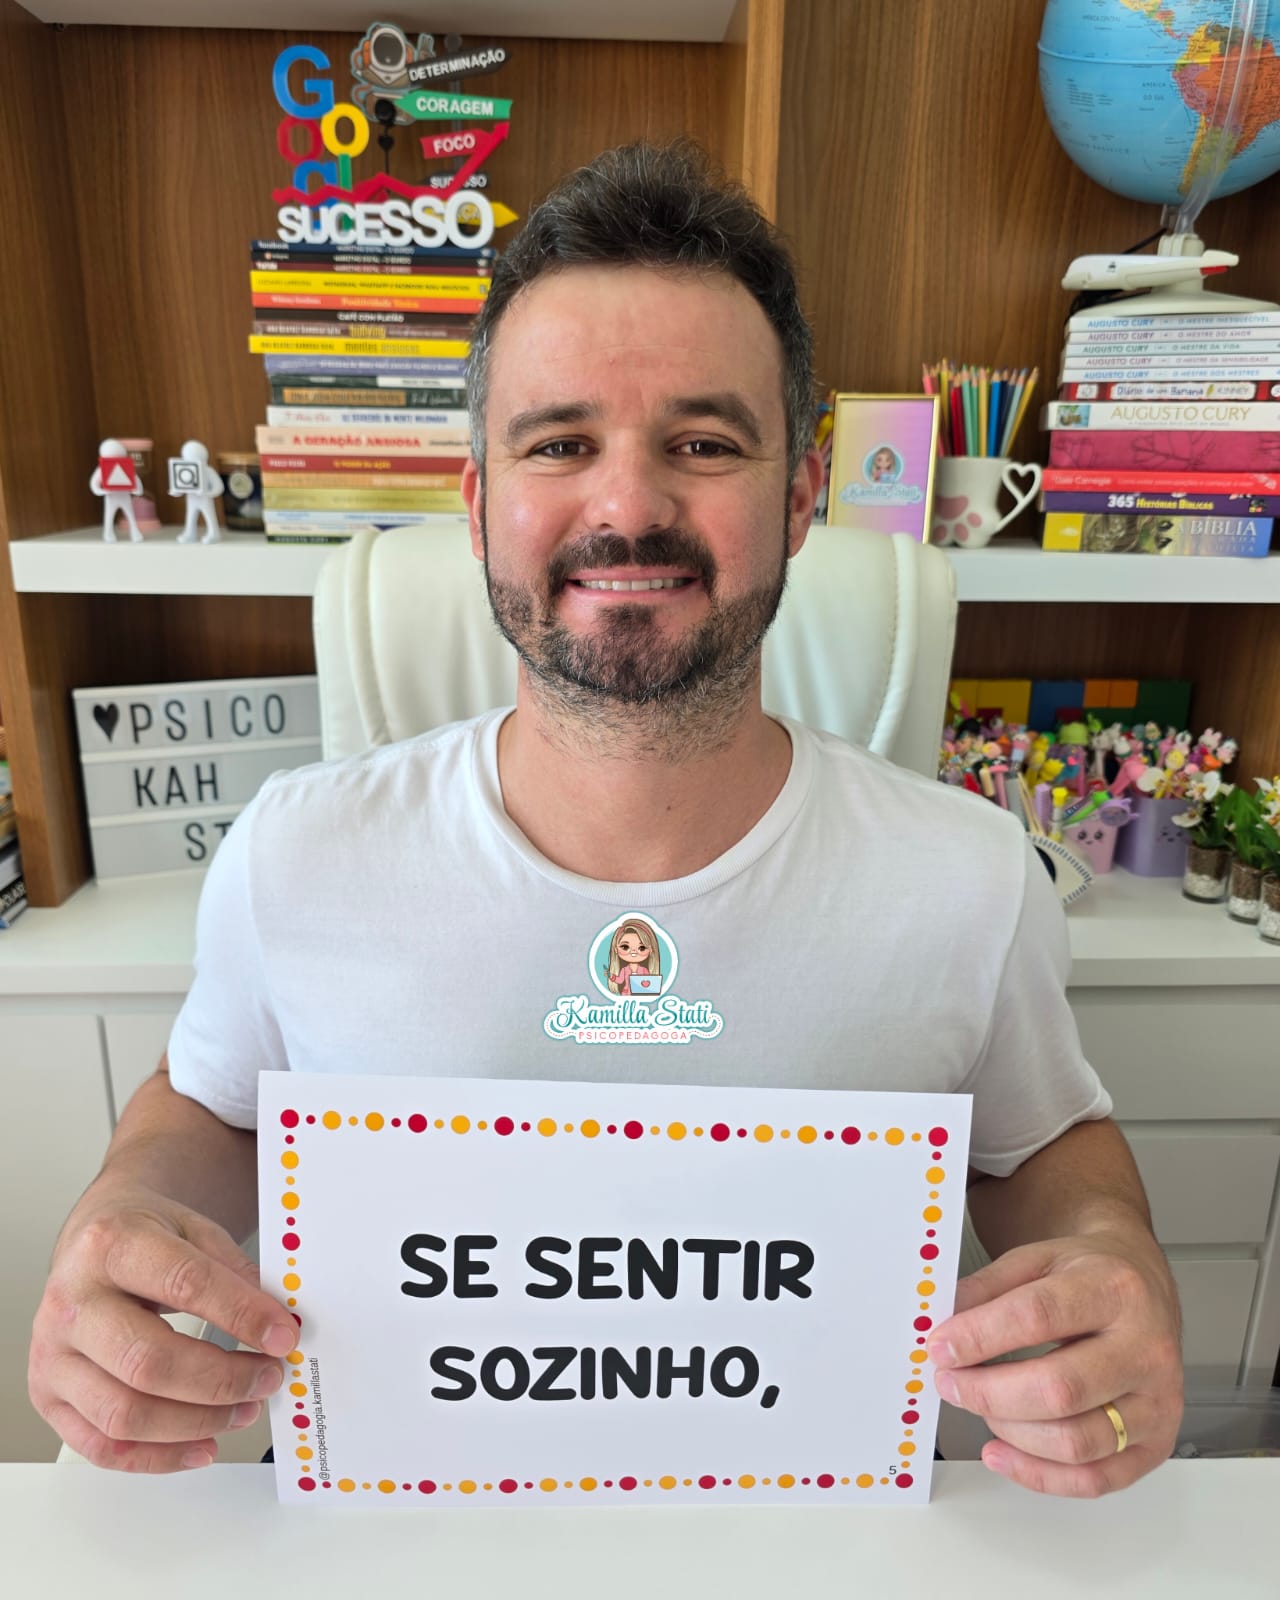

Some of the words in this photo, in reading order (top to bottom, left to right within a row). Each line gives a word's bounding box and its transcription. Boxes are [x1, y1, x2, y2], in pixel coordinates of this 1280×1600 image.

[409, 48, 506, 82] DETERMINAÇÃO
[416, 96, 495, 116] CORAGEM
[433, 133, 476, 155] FOCO
[277, 190, 494, 249] SUCESSO
[1087, 319, 1129, 328] AUGUSTO
[1131, 318, 1154, 327] CURY
[1087, 332, 1129, 341] AUGUSTO
[1131, 331, 1154, 340] CURY
[1082, 345, 1123, 353] AUGUSTO
[1125, 345, 1149, 353] CURY
[1086, 358, 1127, 366] AUGUSTO
[1129, 357, 1152, 366] CURY
[1083, 371, 1124, 379] AUGUSTO
[1127, 371, 1149, 379] CURY
[1110, 405, 1199, 421] AUGUSTO
[1202, 405, 1251, 421] CURY
[304, 432, 362, 449] GERAÇÃO
[1107, 494, 1135, 509] 365
[130, 694, 286, 744] PSICO
[134, 762, 219, 808] KAH
[400, 1233, 499, 1299] SE
[525, 1236, 816, 1301] SENTIR
[429, 1345, 781, 1409] SOZINHO,
[308, 1357, 330, 1481] @psicopedagogia.kamillastati
[888, 1465, 897, 1476] 5
